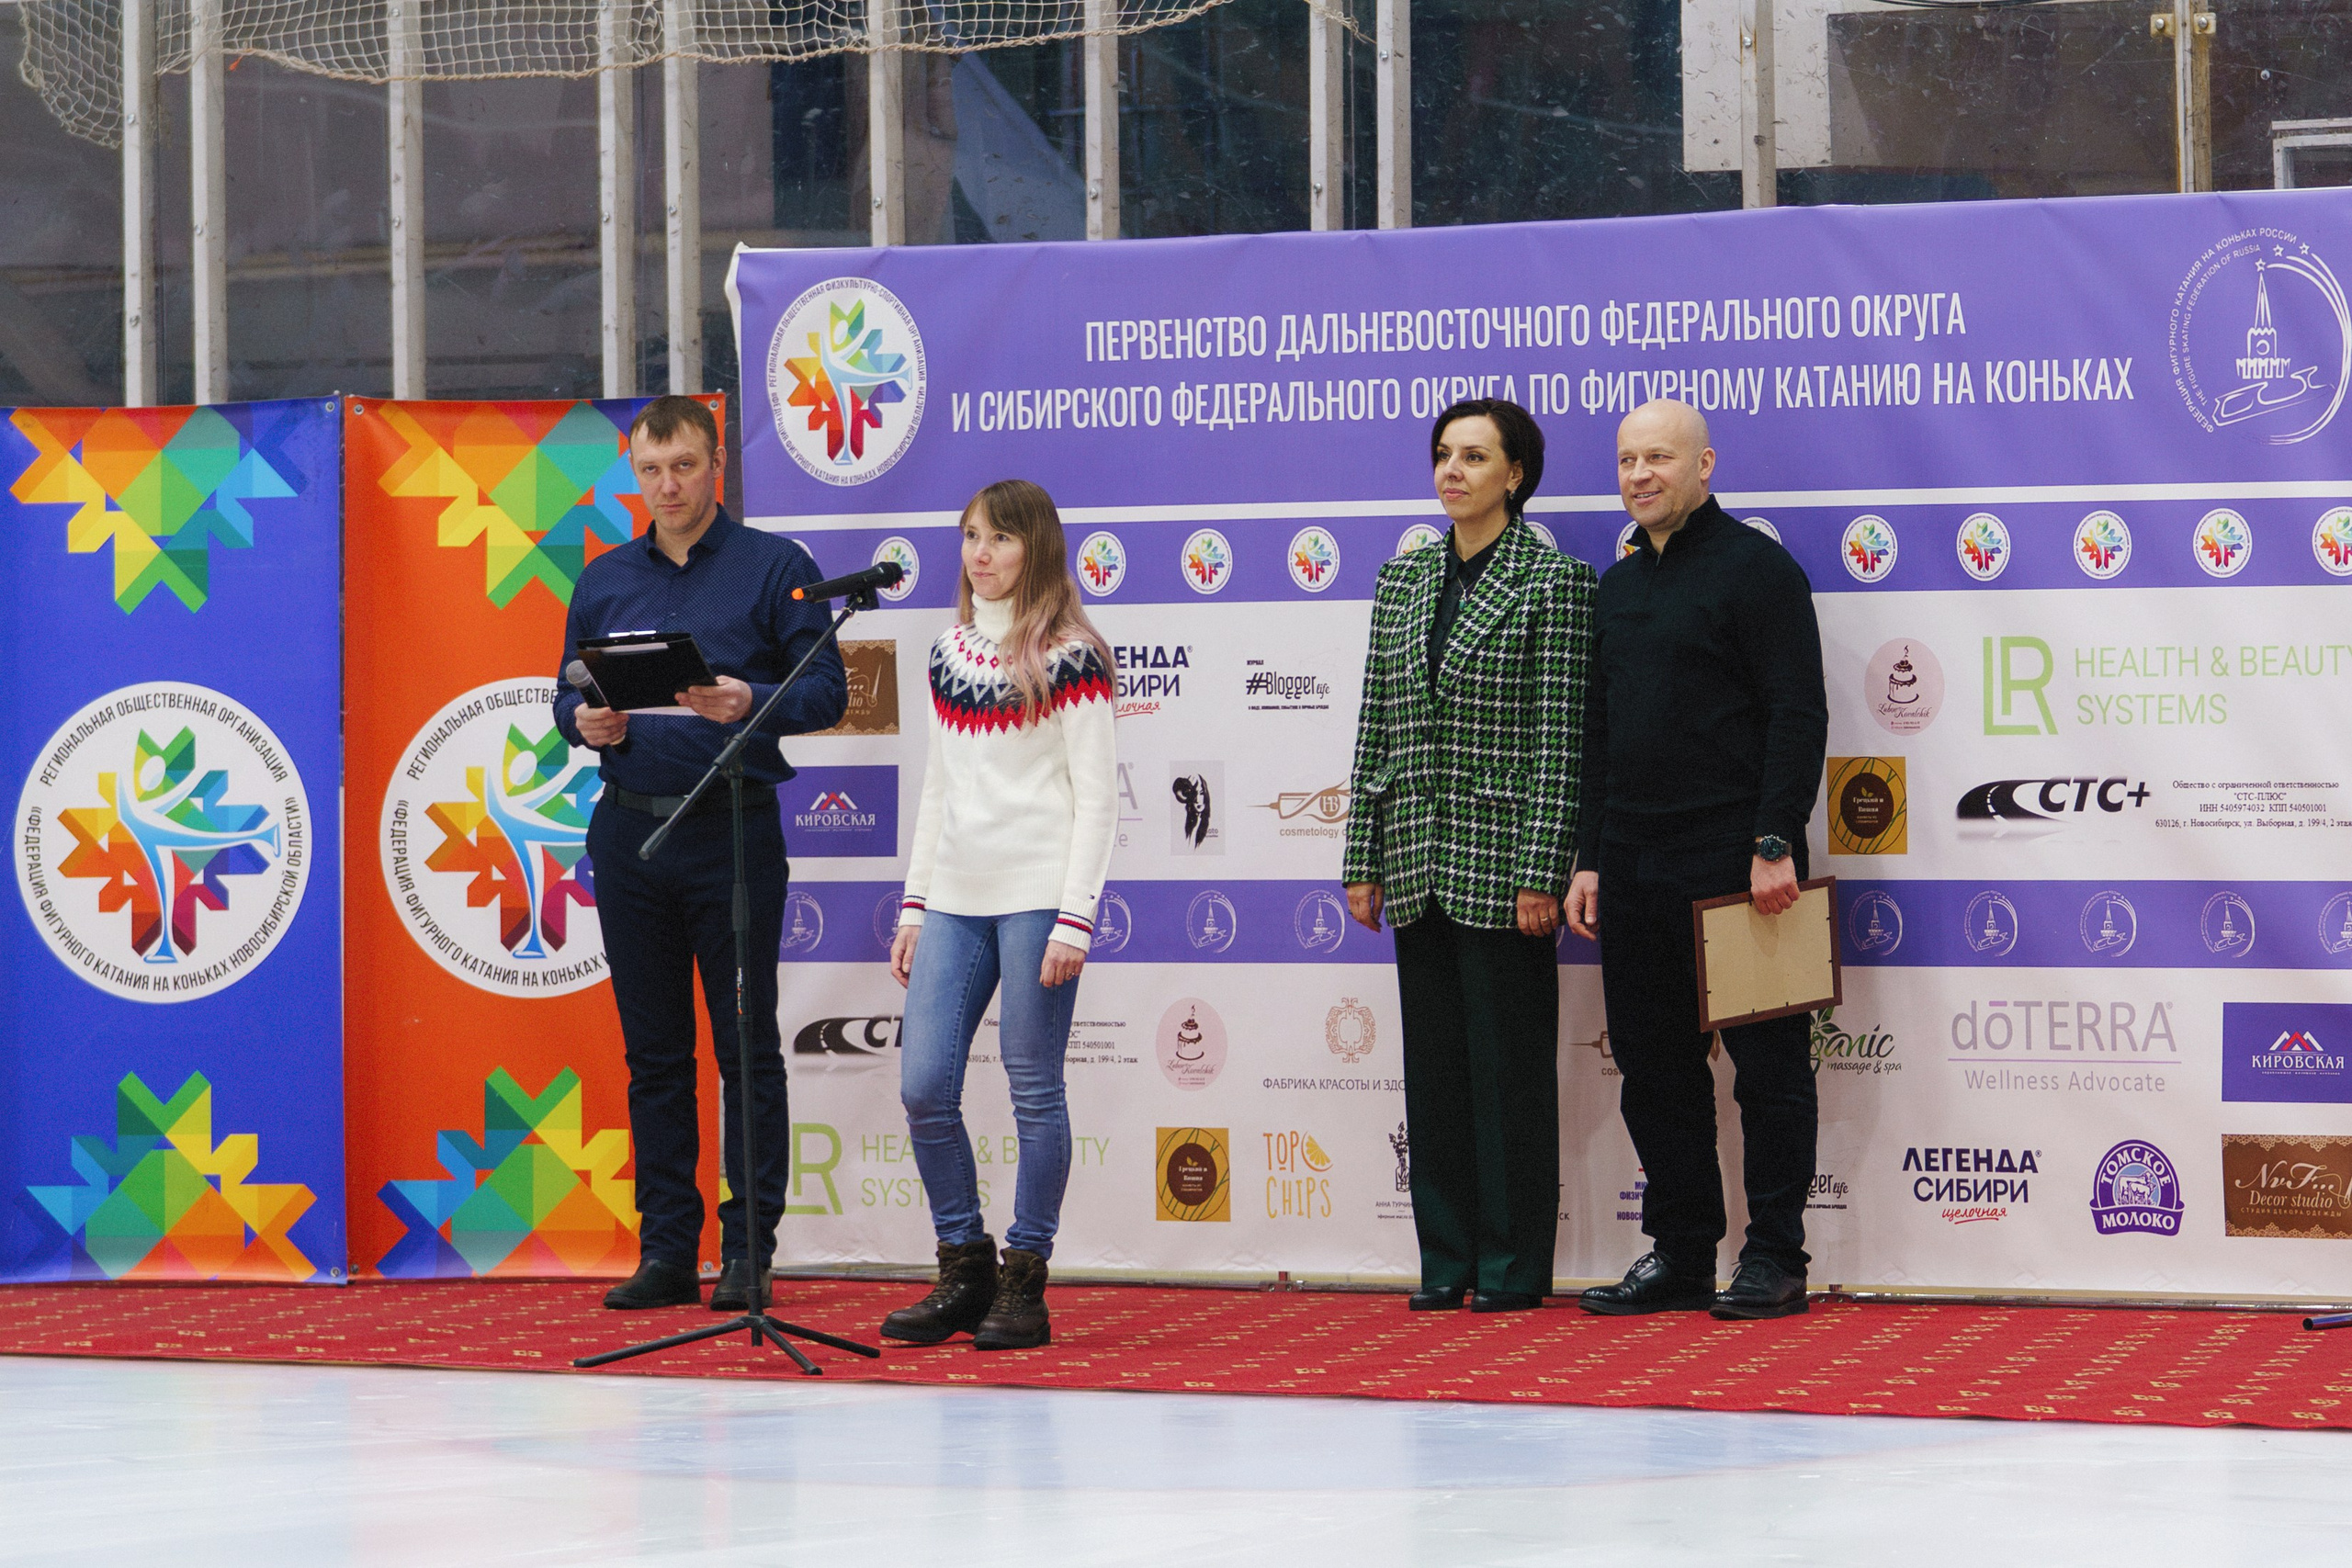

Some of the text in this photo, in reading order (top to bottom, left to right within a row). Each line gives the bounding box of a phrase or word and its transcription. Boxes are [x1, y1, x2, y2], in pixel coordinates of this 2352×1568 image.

[769, 326, 785, 388] РЕГИОНАЛЬНАЯ
[781, 287, 825, 328] ОБЩЕСТВЕННАЯ
[908, 324, 925, 381] ОРГАНИЗАЦИЯ
[1085, 292, 1967, 362] ПЕРВЕНСТВО ДАЛЬНЕВОСТОЧНОГО ФЕДЕРАЛЬНОГО ОКРУГА
[2169, 228, 2297, 433] ФЕДЕРАЦИЯ ФИГУРНОГО КАТАНИЯ НА КОНЬКАХ РОССИИ
[2182, 243, 2260, 406] THE FIGURE SKATING FEDERATION OF RUSSIA
[952, 392, 970, 432] И
[978, 385, 1162, 431] СИБИРСКОГО
[1171, 378, 1401, 431] ФЕДЕРАЛЬНОГО
[1529, 372, 1570, 415] ПО
[1580, 367, 1765, 415] ФИГУРНОМУ
[1775, 362, 1922, 409] КАТАНИЮ
[1933, 360, 1975, 404] НА
[1985, 357, 2134, 404] КОНЬКАХ
[786, 438, 815, 475] ФИГУРНОГО
[815, 467, 840, 484] КАТАНИЯ
[841, 475, 849, 485] НА
[849, 468, 877, 485] КОНЬКАХ
[876, 424, 916, 475] НОВОСИБИРСКОЙ
[1114, 646, 1190, 669] ЕНДА
[2075, 647, 2199, 678] HEALTH
[2211, 646, 2229, 677] &
[1117, 673, 1180, 697] БИРИ
[1246, 671, 1317, 699] #Blogger
[1983, 637, 2059, 735] LR
[1115, 701, 1160, 712] лочная
[2077, 694, 2227, 725] SYSTEMS
[40, 693, 288, 786] РЕГИОНАЛЬНАЯ ОБЩЕСТВЕННАЯ ОРГАНИЗАЦИЯ
[407, 688, 558, 781] РЕГИОНАЛЬНАЯ ОБЩЕСТВЕ
[2173, 781, 2209, 789] Общество
[2218, 781, 2271, 790] ограниченной
[796, 814, 876, 827] КИРОВСКАЯ
[2199, 804, 2326, 812] ИНН 5405974032 КПП 540501001
[1280, 827, 1339, 839] cosmetology
[2155, 819, 2181, 829] 630126,
[2190, 818, 2241, 829] Новосибирск,
[2256, 818, 2296, 828] Выборная,
[40, 899, 95, 965] ФИГУРНОГО
[93, 961, 150, 990] КАТАНИЯ
[153, 976, 169, 991] НА
[173, 963, 230, 990] КОНЬКАХ
[229, 871, 299, 967] НОВОСИБИРСКОЙ
[405, 893, 462, 961] ФИГУРНОГО
[460, 955, 518, 986] КАТАНИЯ
[522, 971, 539, 987] НА
[542, 957, 602, 987] КОНЬКАХ
[1065, 1055, 1090, 1064] борная,
[1827, 1060, 1902, 1075] massage & spa
[2252, 1055, 2345, 1069] КИРОВСКАЯ
[1262, 1077, 1317, 1090] ФАБРИКА
[1319, 1078, 1370, 1090] КРАСОТЫ
[1373, 1079, 1381, 1090] И
[1965, 1070, 2165, 1091] Wellness Advocate
[862, 1134, 917, 1163] HEA
[977, 1136, 993, 1164] &
[1263, 1130, 1299, 1172] TOP
[1902, 1147, 2039, 1173] ЛЕГЕНДА
[2101, 1147, 2171, 1187] ТОМСКОЕ
[1266, 1176, 1331, 1219] CHIPS
[1914, 1177, 2029, 1203] СИБИРИ
[2249, 1190, 2333, 1208] Decor studio
[1942, 1207, 2007, 1222] щелочная
[2102, 1211, 2176, 1231] МОЛОКО
